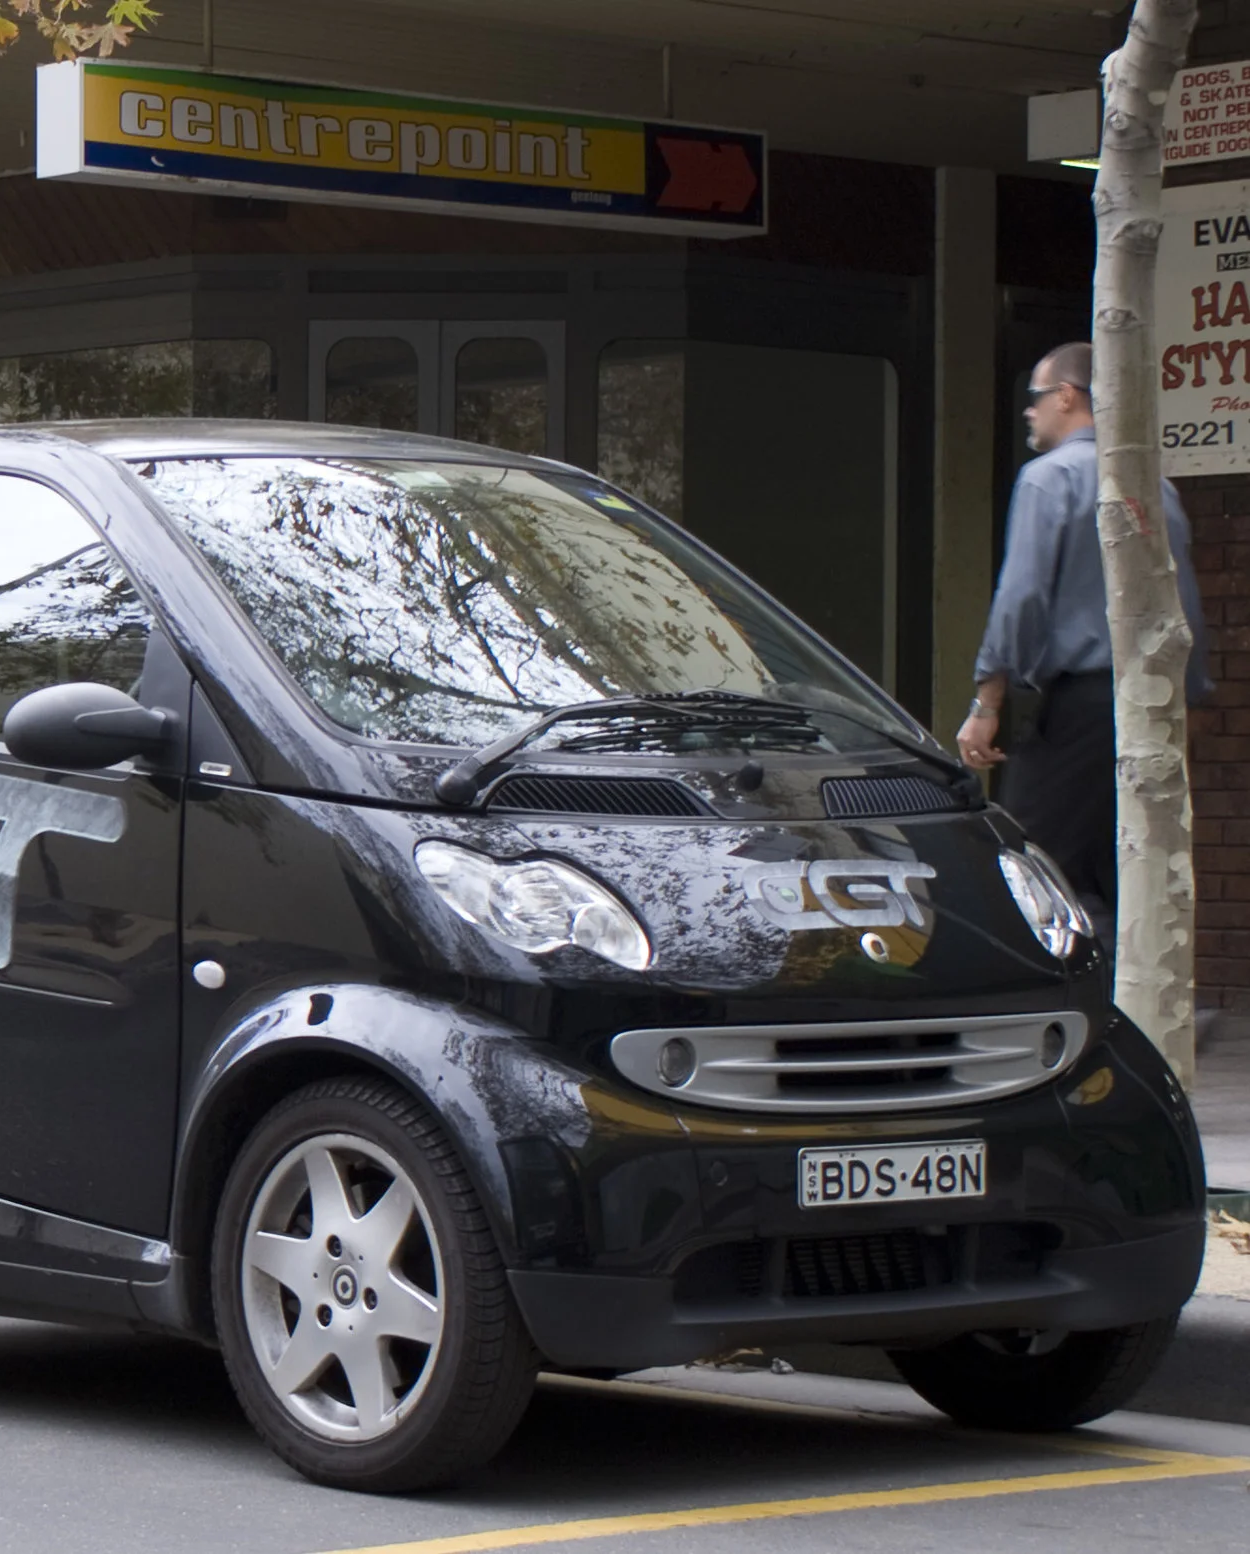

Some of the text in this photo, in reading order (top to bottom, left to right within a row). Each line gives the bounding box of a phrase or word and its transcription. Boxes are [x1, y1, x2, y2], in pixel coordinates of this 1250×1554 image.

[1182, 69, 1235, 88] DOGS,
[1183, 106, 1219, 123] NOT
[120, 90, 591, 180] centrepoint
[1163, 127, 1178, 142] N
[1217, 136, 1250, 154] DOG
[1218, 252, 1250, 271] ME
[1191, 281, 1250, 332] HA
[1162, 420, 1234, 449] 5221
